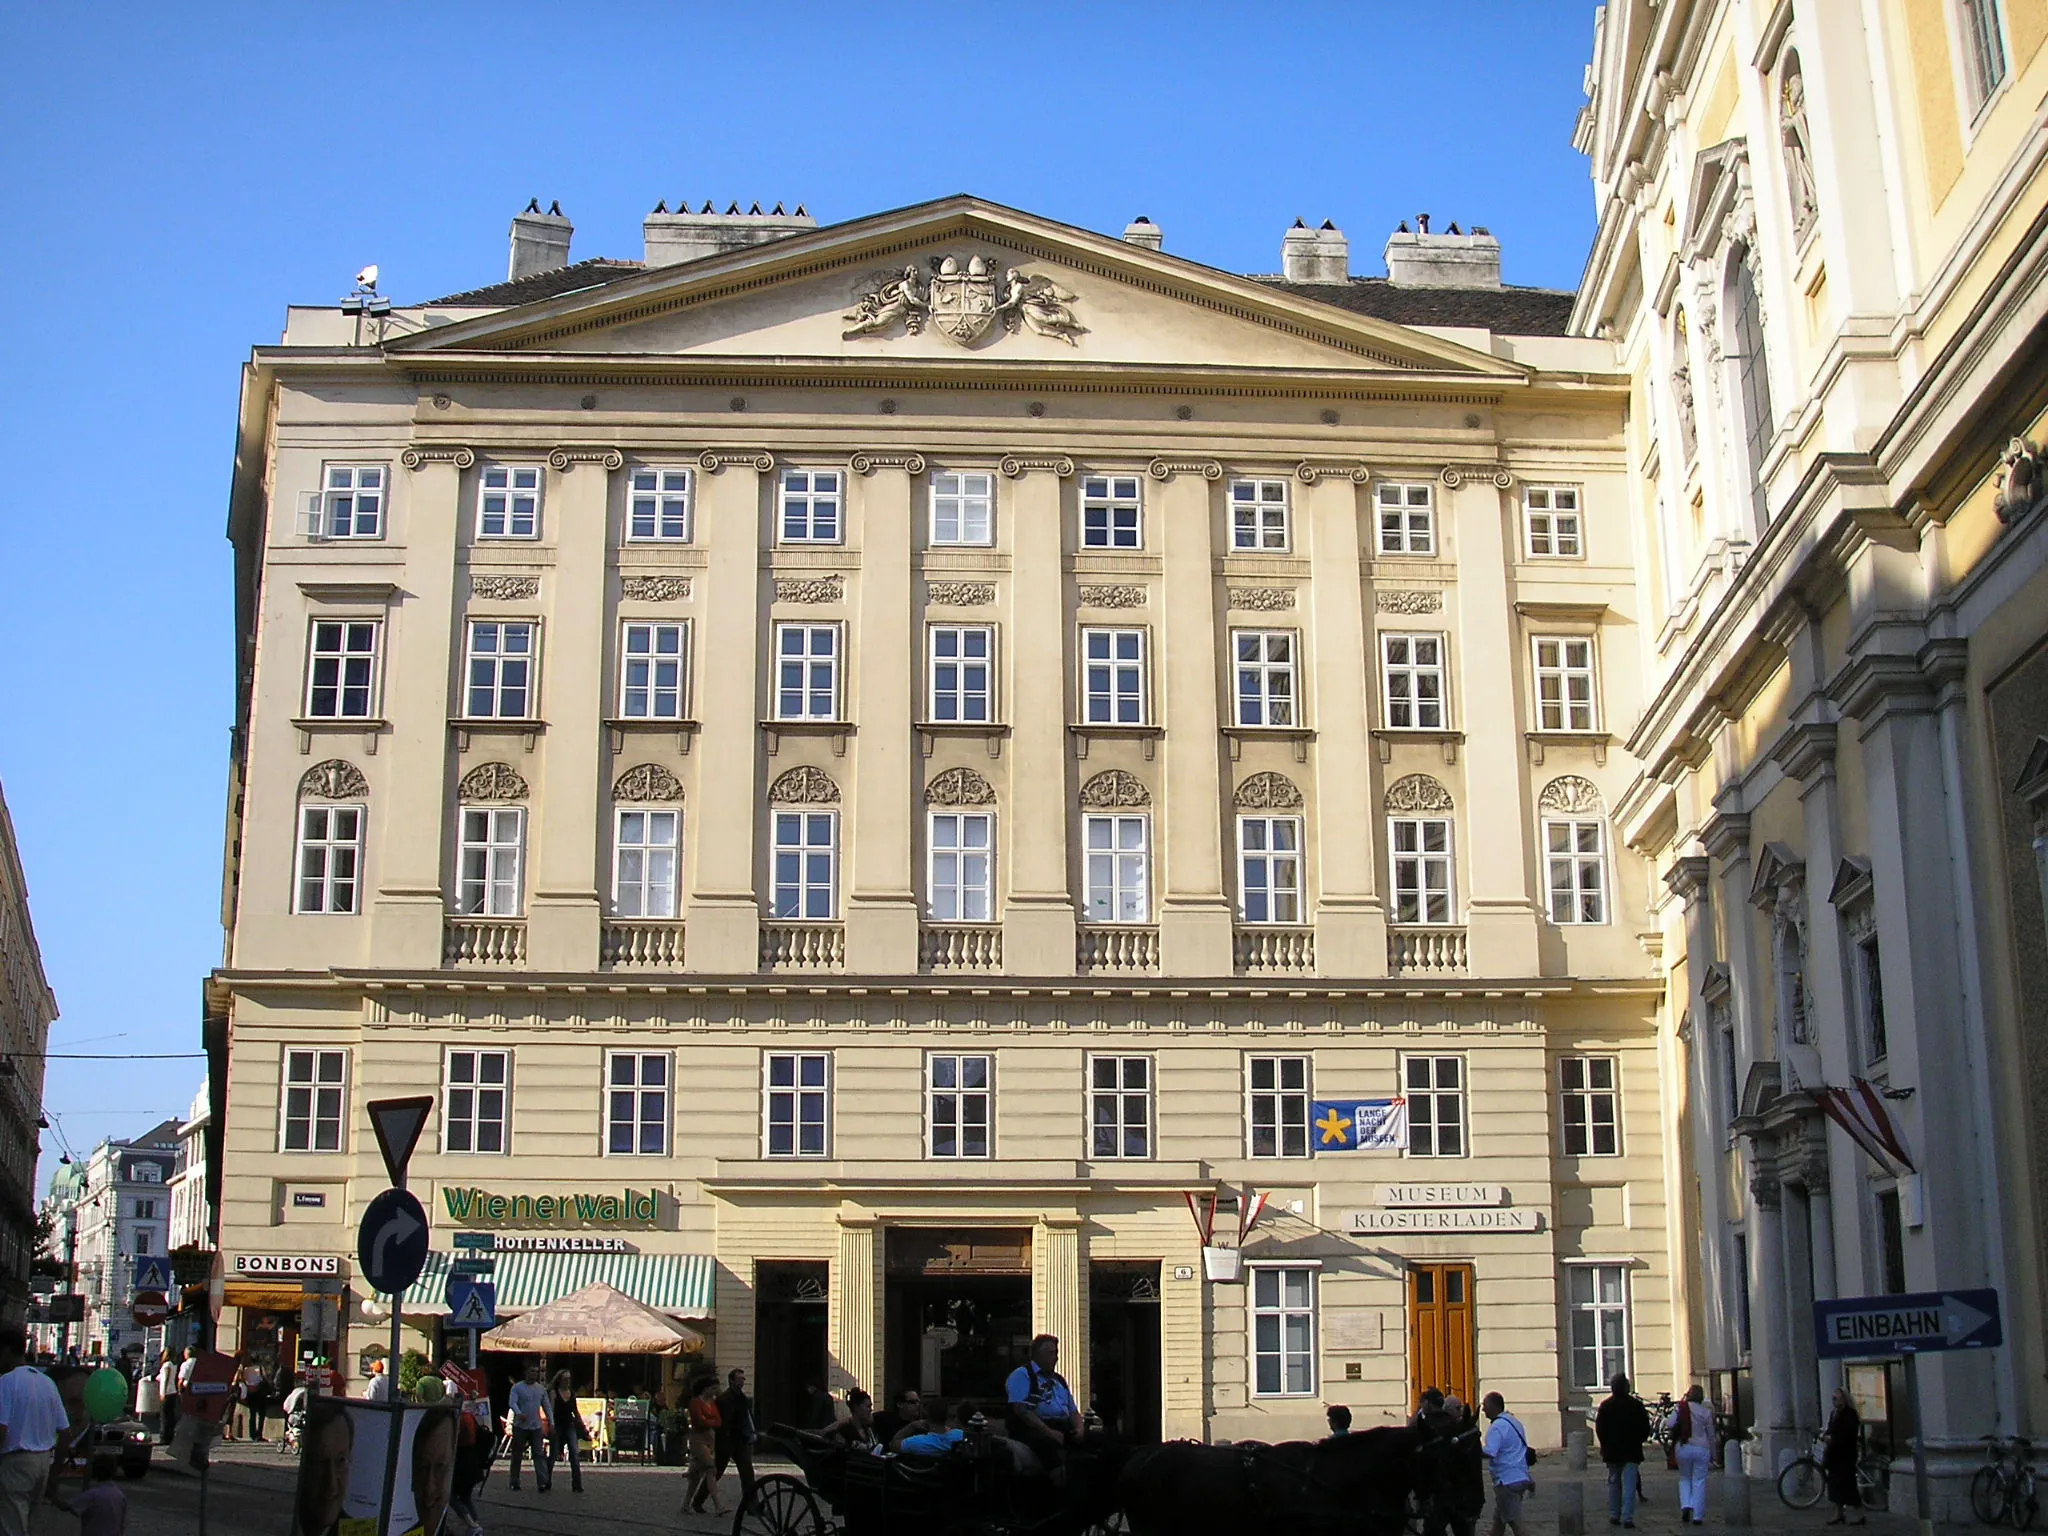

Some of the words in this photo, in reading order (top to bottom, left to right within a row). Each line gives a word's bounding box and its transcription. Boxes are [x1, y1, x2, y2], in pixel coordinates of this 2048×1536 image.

[1359, 1109, 1387, 1118] LANGE
[1359, 1118, 1387, 1126] NACHT
[1360, 1126, 1377, 1135] DER
[1389, 1187, 1488, 1202] MUSEUM
[442, 1186, 659, 1221] Wienerwald
[1354, 1212, 1523, 1228] KLOSTERLADEN
[493, 1236, 626, 1251] HOTTENKELLER
[236, 1256, 335, 1271] BONBONS
[1836, 1310, 1941, 1340] EINBAHN
